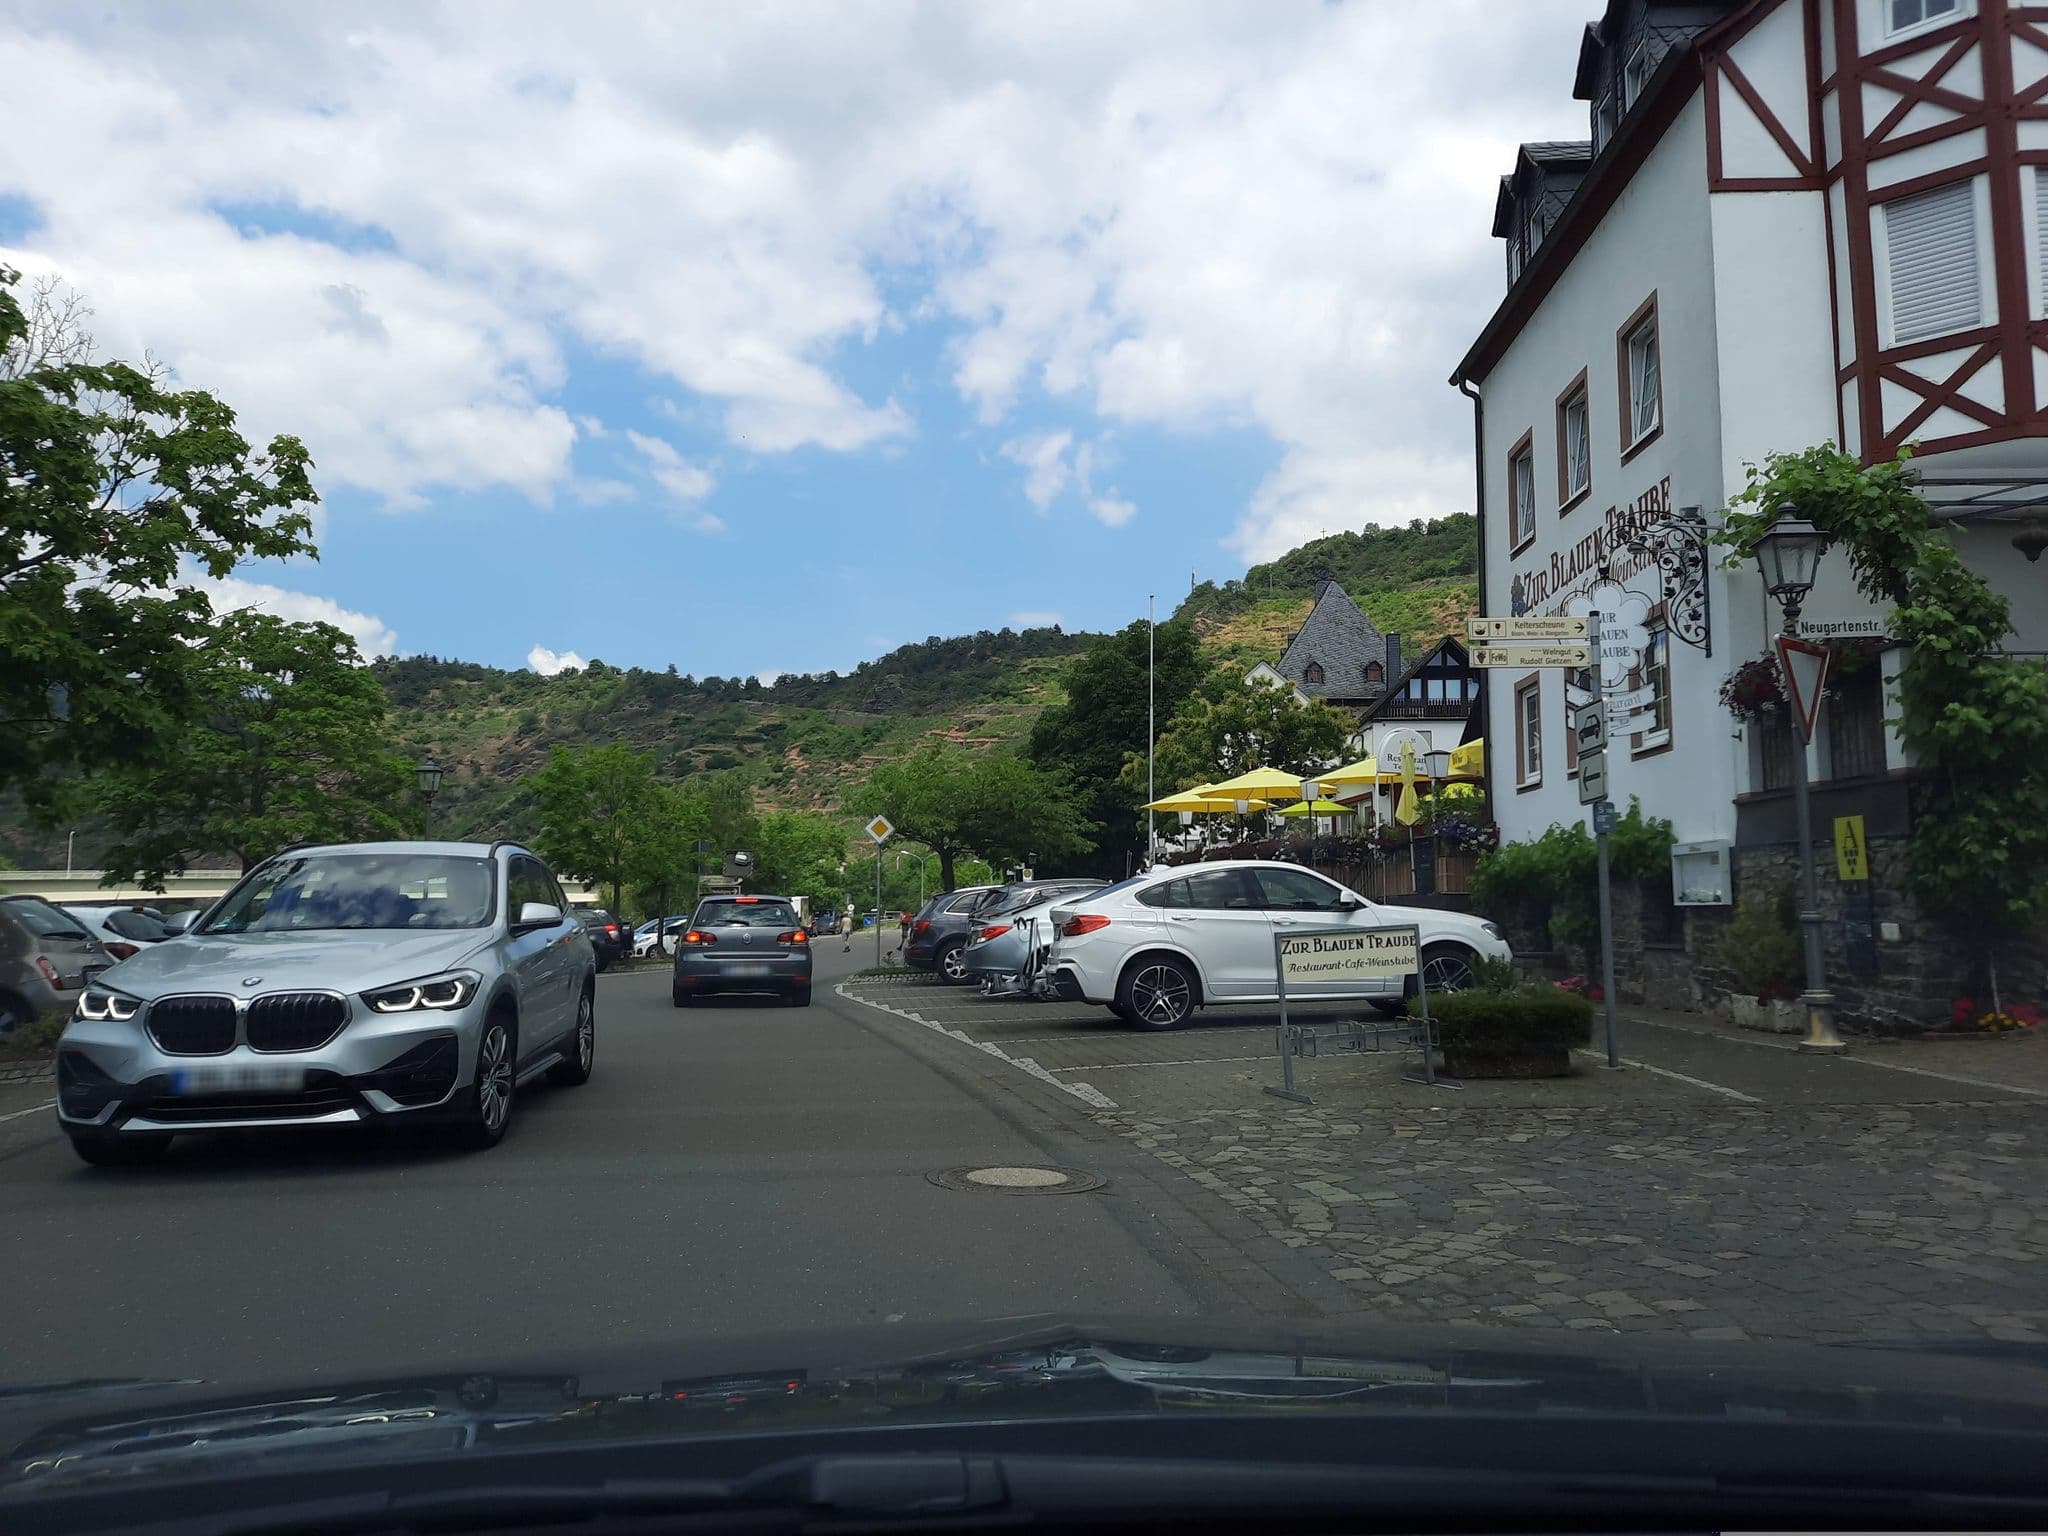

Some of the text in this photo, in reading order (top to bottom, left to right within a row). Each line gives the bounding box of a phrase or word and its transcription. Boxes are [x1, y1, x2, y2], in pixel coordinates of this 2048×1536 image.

[1524, 571, 1550, 613] ZUR
[1550, 526, 1604, 595] BLAUEN
[1605, 474, 1672, 551] TRAUBE
[1800, 619, 1881, 636] Neugartenstr.
[1520, 657, 1543, 665] Rudolf
[1542, 648, 1571, 657] Weingut
[1281, 935, 1417, 955] ZUR BLAUEN TRAUBE
